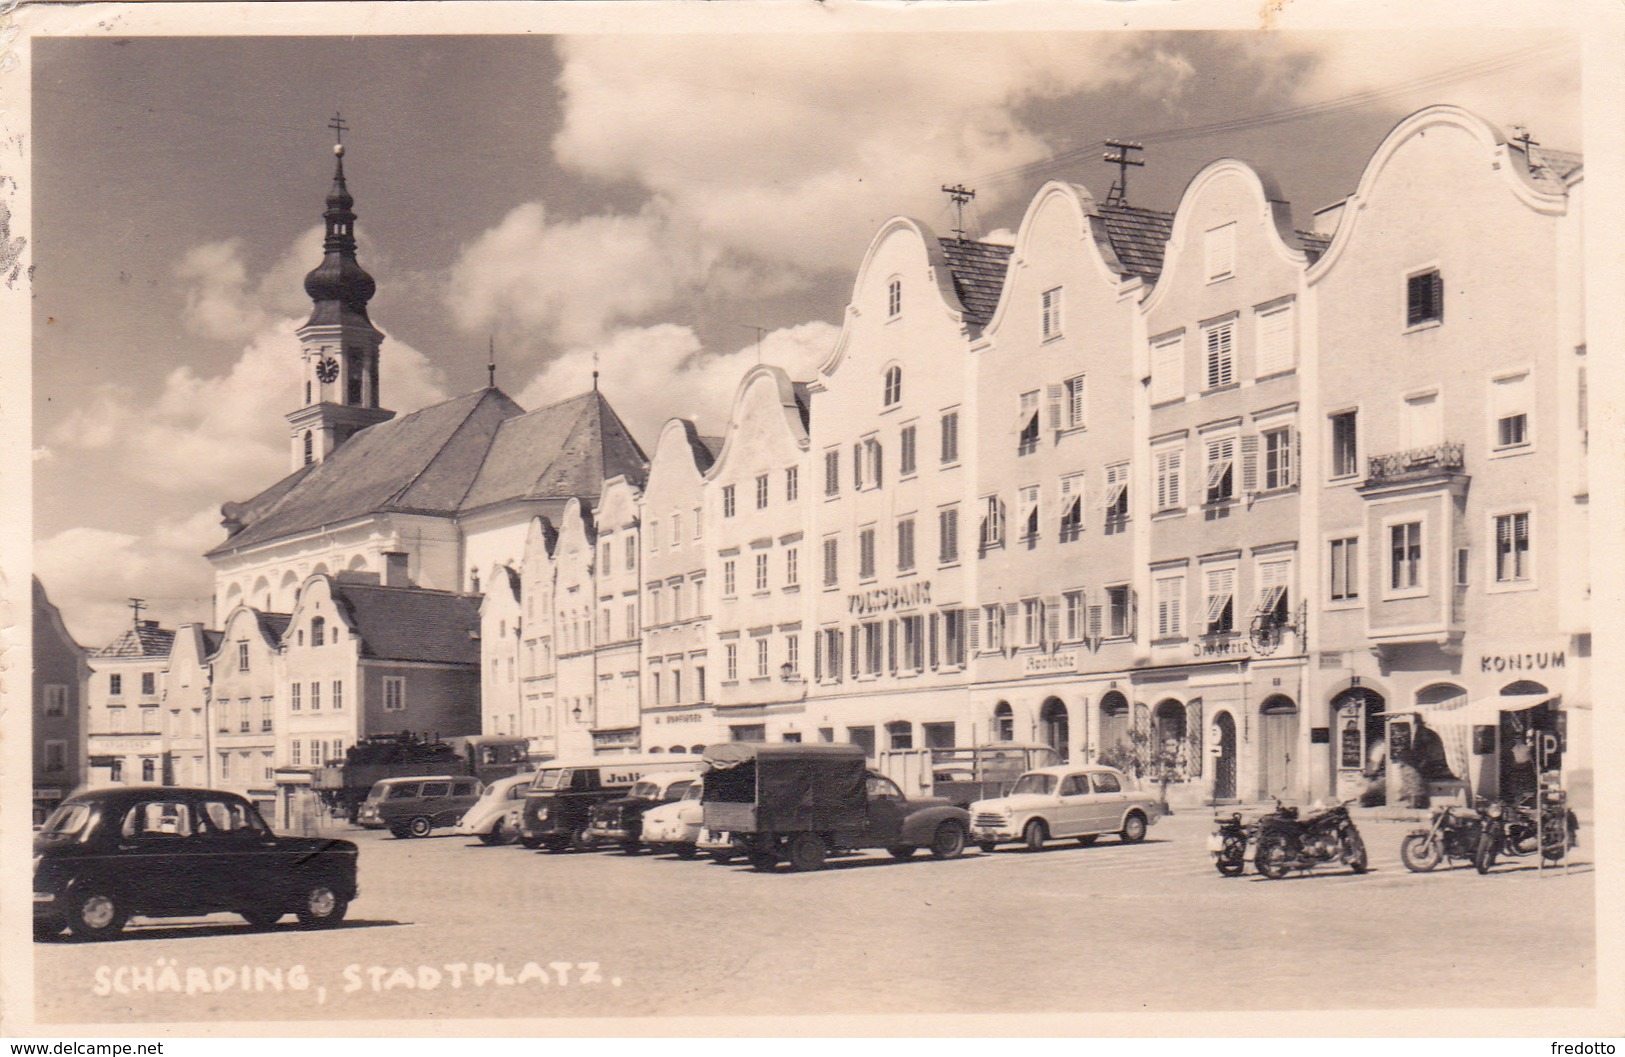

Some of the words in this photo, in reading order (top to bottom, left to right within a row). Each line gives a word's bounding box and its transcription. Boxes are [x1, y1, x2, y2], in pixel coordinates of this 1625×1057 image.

[848, 580, 931, 614] VOLKSBANK
[1026, 656, 1074, 670] Apotheke
[1193, 641, 1249, 657] Drogerie
[1481, 651, 1565, 673] KONSUM
[1543, 734, 1558, 768] P
[94, 957, 327, 1005] SCHÄRDING,
[342, 961, 623, 994] STADTPLATZ.
